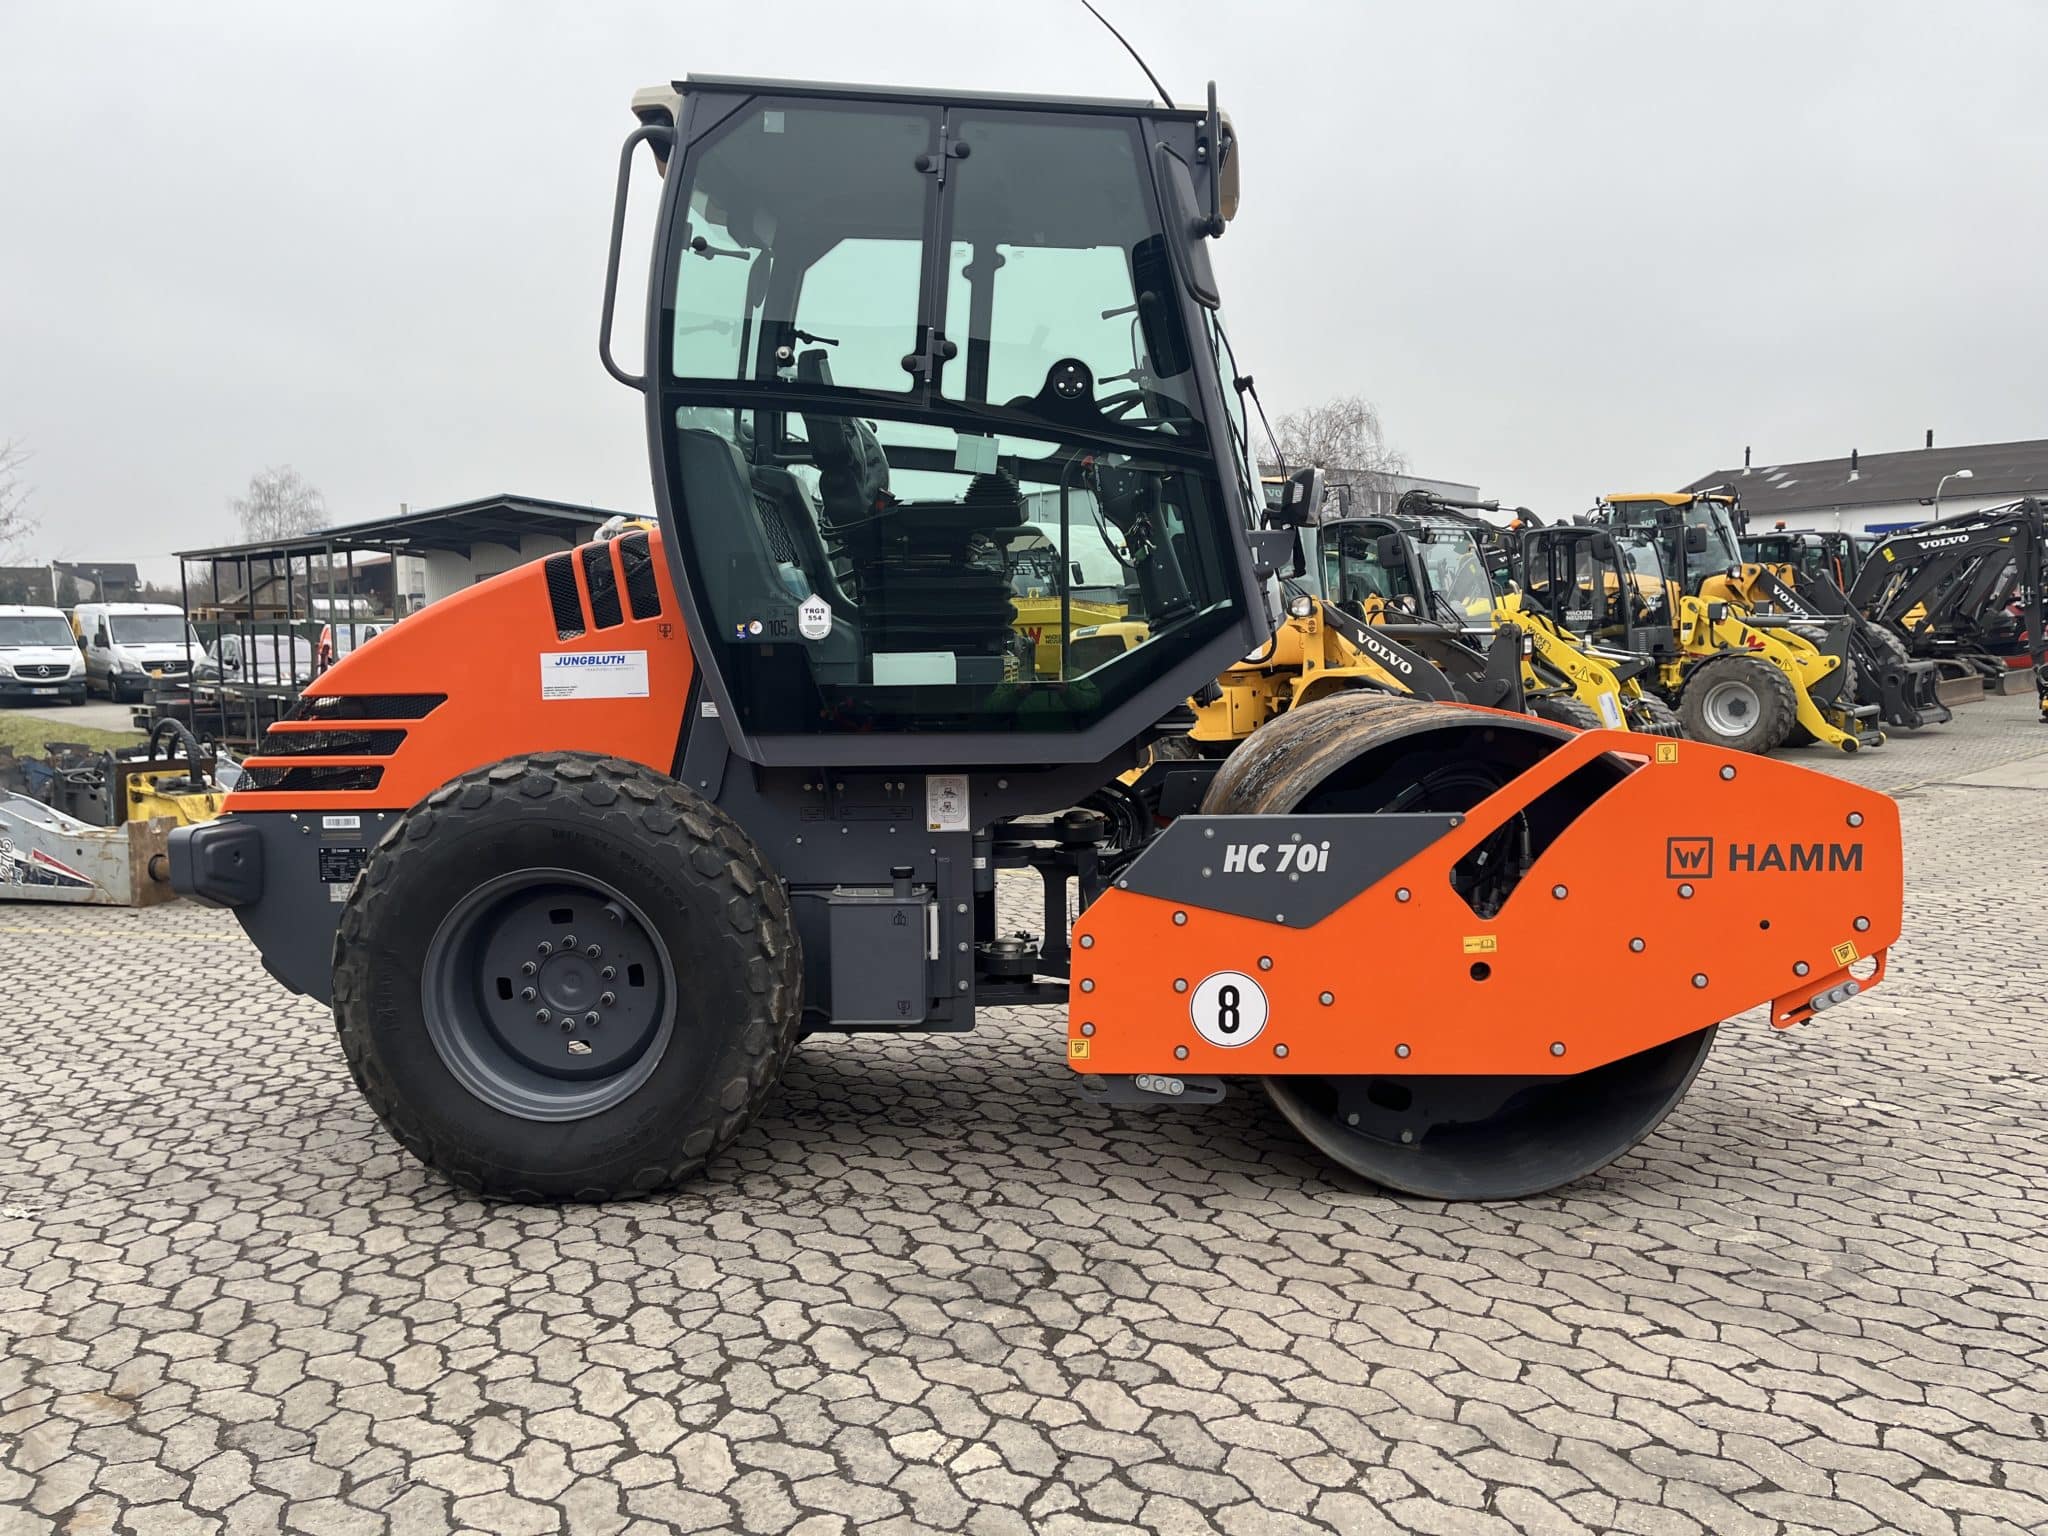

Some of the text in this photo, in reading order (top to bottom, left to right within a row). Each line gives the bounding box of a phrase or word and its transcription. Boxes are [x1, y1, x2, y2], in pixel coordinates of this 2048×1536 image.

[1918, 534, 1970, 550] VOLVO
[803, 607, 826, 615] TRGS
[1773, 583, 1809, 620] VOLVO
[768, 620, 788, 637] 105
[554, 654, 626, 666] JUNGBLUTH
[1356, 628, 1413, 675] VOLVO
[1222, 840, 1331, 873] HC 70i
[1728, 843, 1864, 872] HAMM
[1217, 984, 1240, 1035] 8
